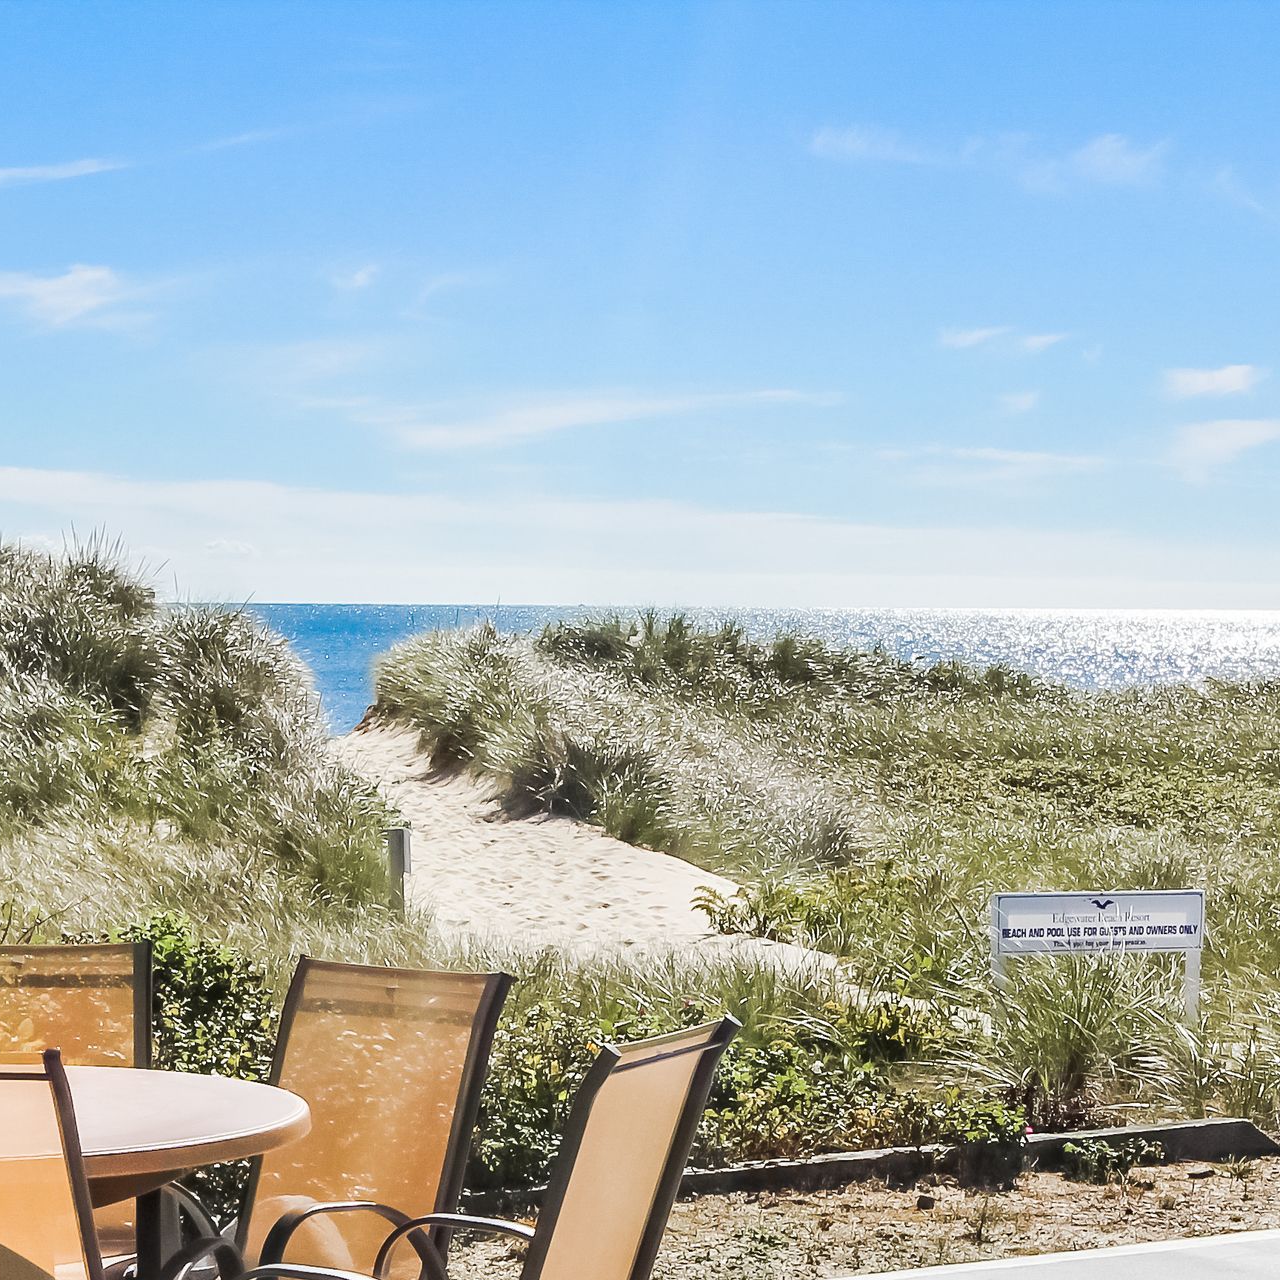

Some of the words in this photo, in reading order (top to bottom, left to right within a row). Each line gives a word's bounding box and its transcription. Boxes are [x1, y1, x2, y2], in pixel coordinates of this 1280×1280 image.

[1002, 928, 1027, 938] BEACH
[1029, 928, 1045, 938] AND
[1047, 928, 1065, 938] POOL
[1067, 927, 1081, 937] USE
[1083, 927, 1097, 936] FOR
[1128, 926, 1144, 936] AND
[1146, 925, 1177, 935] OWNERS
[1179, 925, 1198, 935] ONLY
